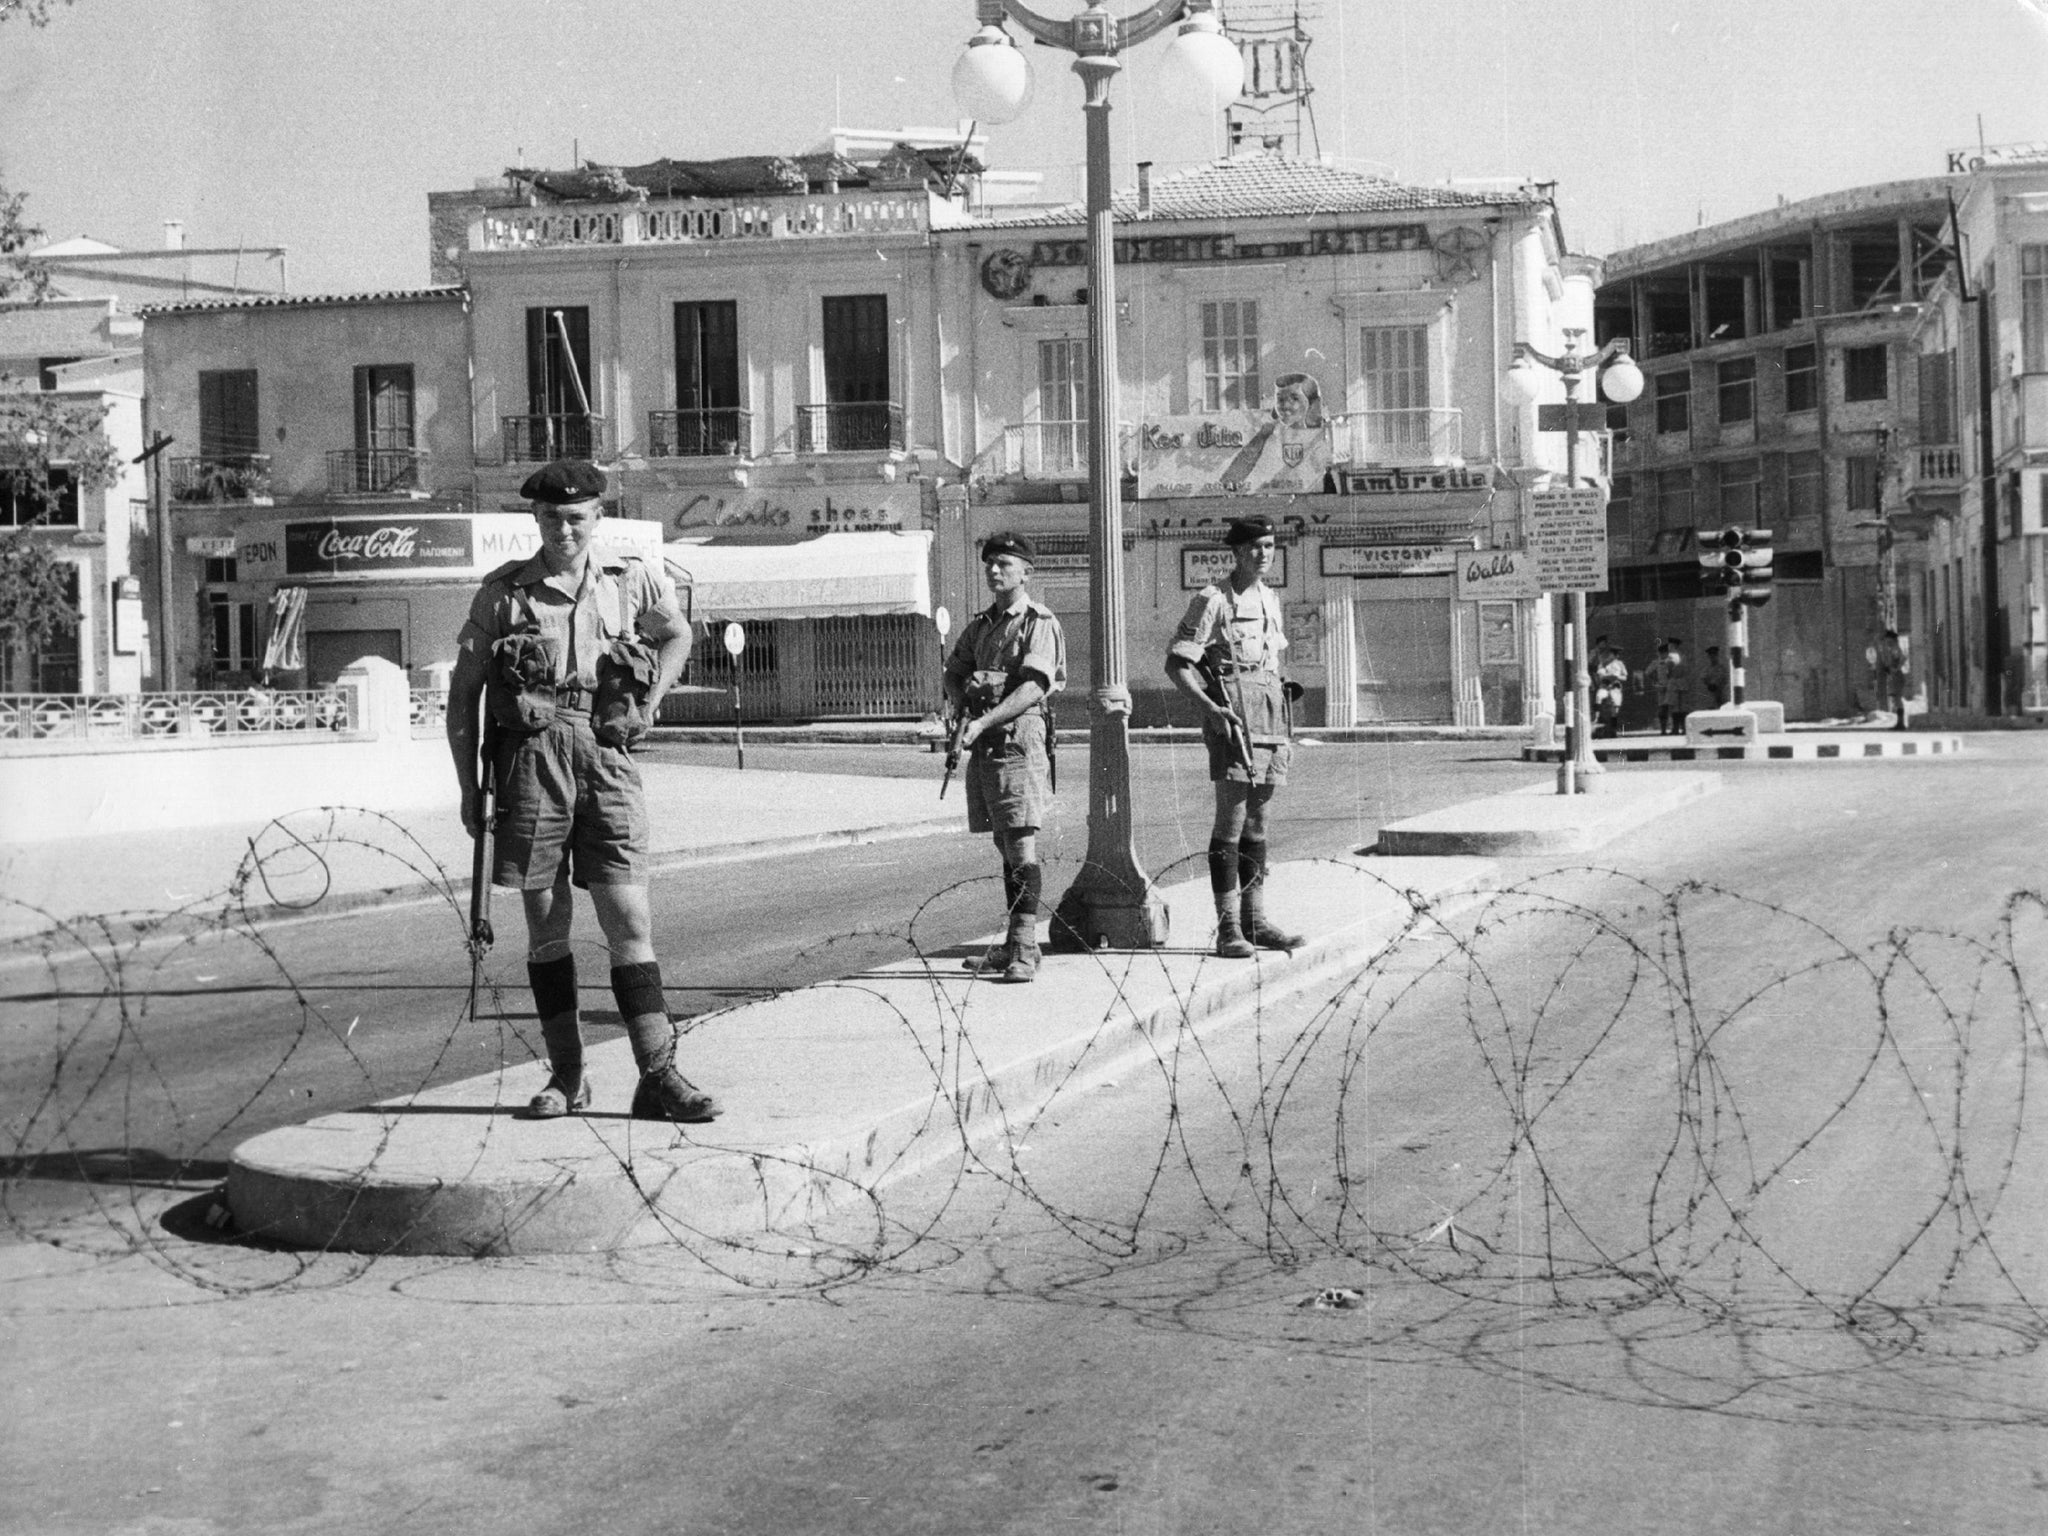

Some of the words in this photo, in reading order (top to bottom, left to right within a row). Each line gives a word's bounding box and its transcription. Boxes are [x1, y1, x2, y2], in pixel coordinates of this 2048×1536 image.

[673, 494, 791, 530] Clarks
[809, 497, 889, 523] shoes
[317, 526, 419, 560] Coca-Cola
[482, 533, 537, 553] ΜΙΛΤ
[1192, 554, 1233, 566] PROVI
